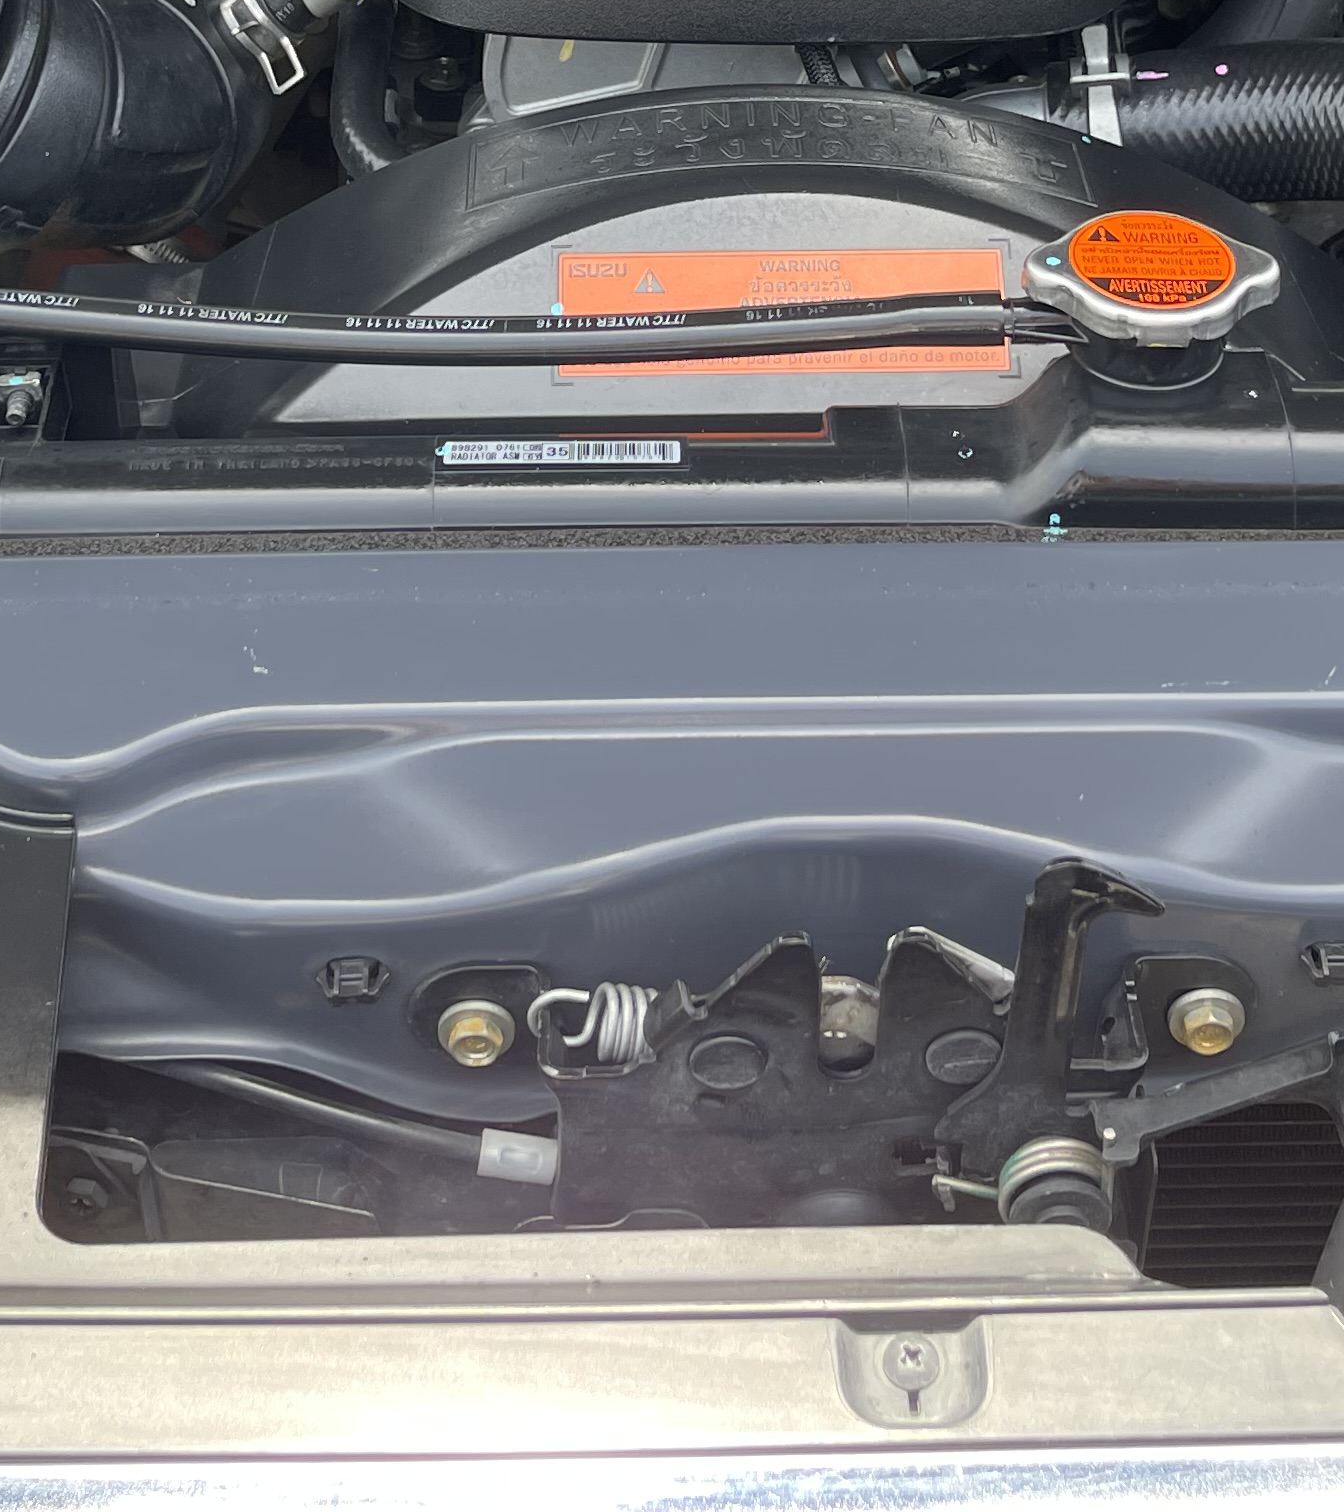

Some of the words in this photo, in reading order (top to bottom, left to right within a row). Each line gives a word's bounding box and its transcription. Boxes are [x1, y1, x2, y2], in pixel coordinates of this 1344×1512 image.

[1123, 231, 1198, 244] WARNING
[567, 263, 628, 278] ISUZU
[759, 259, 841, 273] WARNING
[1109, 278, 1208, 294] AVERTISSEMENT
[137, 304, 154, 314] 16
[159, 305, 174, 316] 11
[179, 307, 194, 317] 11
[198, 308, 252, 322] WATER
[346, 317, 362, 327] 16
[367, 317, 382, 328] 11
[386, 318, 401, 329] 11
[406, 318, 458, 329] WATER
[536, 318, 552, 329] 16
[557, 318, 572, 329] 11
[578, 317, 593, 328] 11
[596, 315, 650, 328] WATER
[451, 452, 496, 461] RADIATOR
[546, 446, 569, 457] 35
